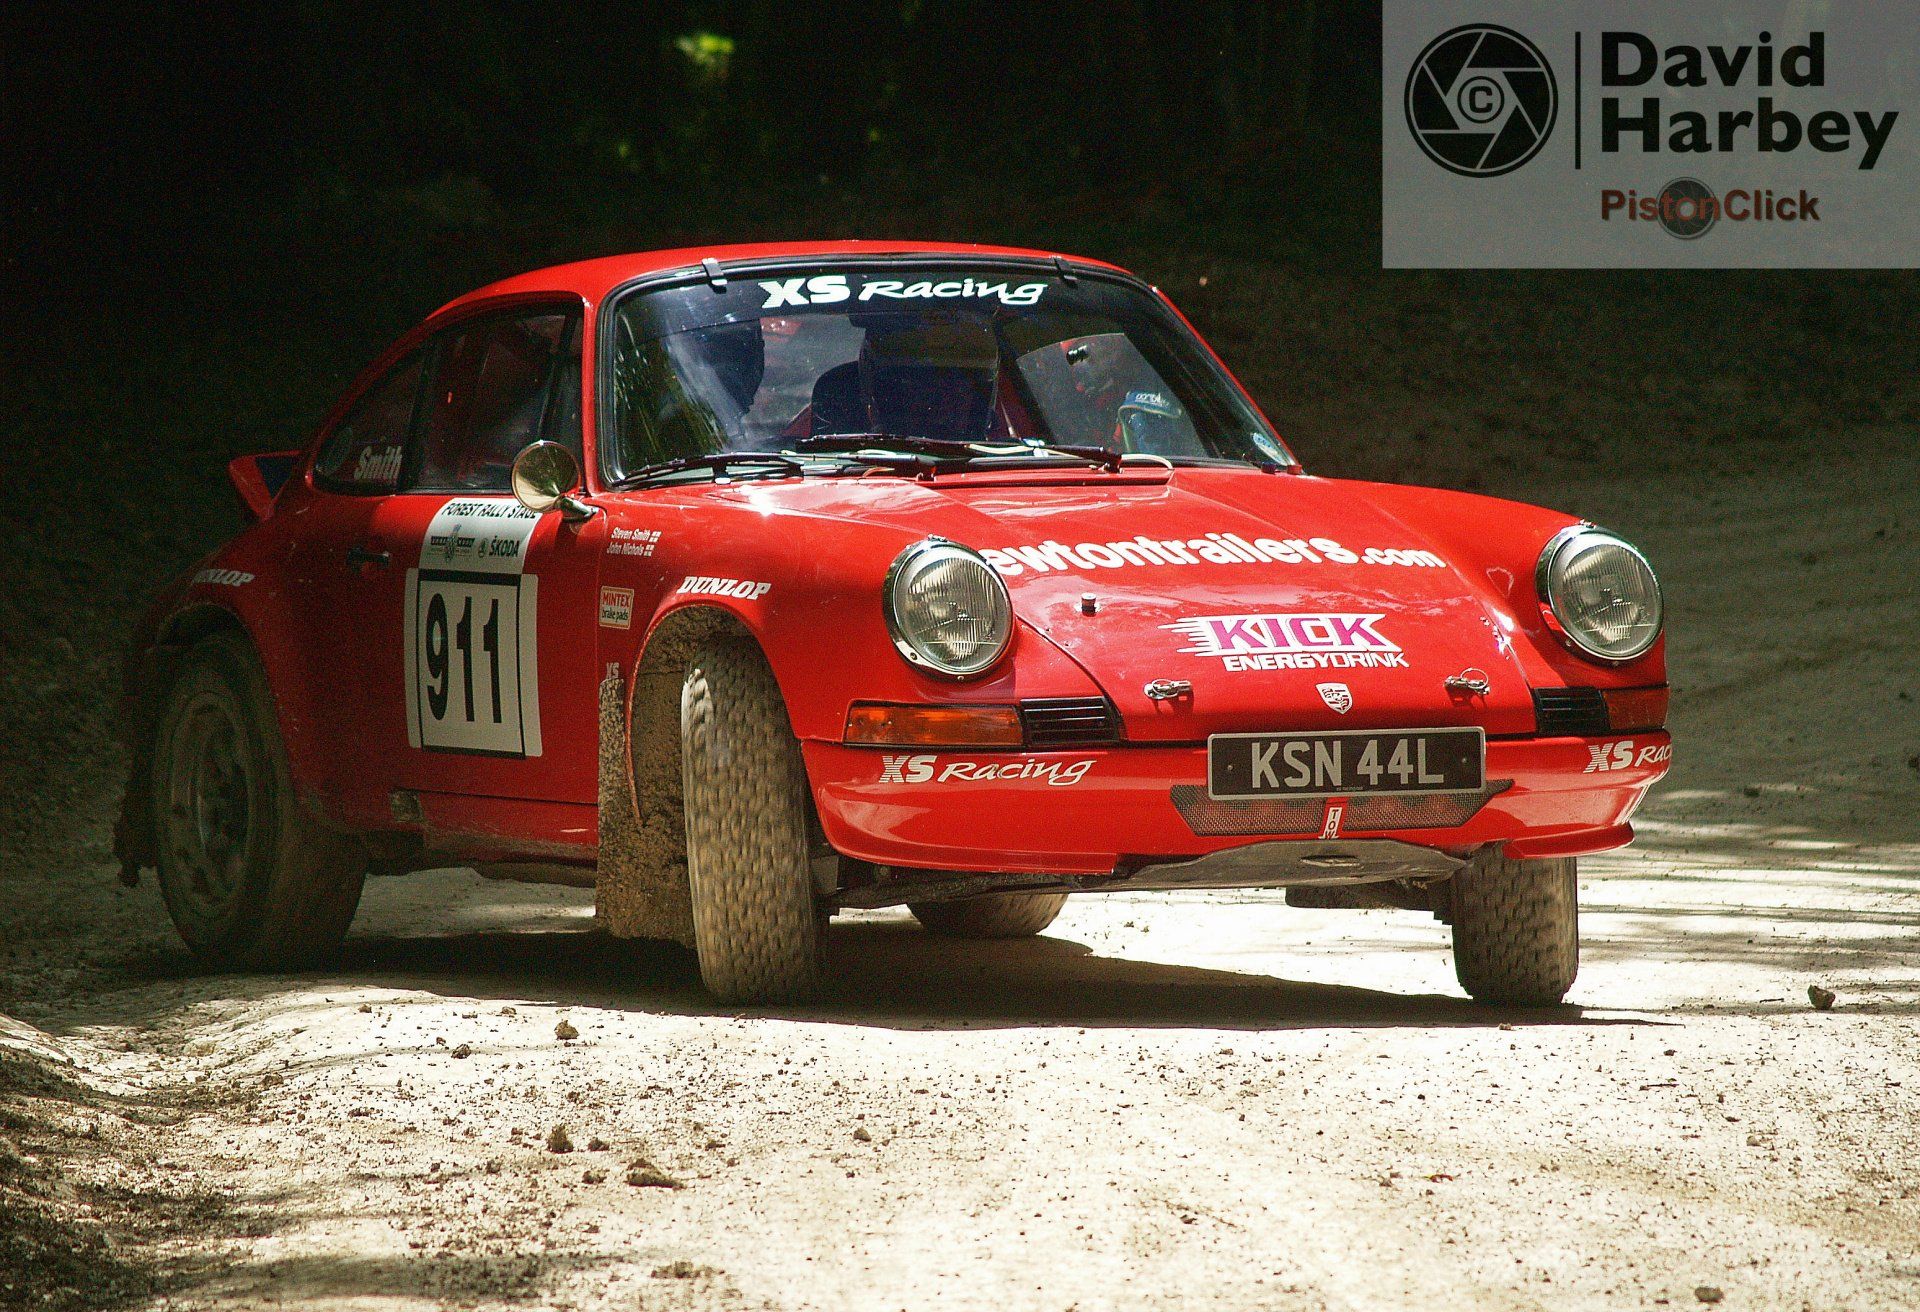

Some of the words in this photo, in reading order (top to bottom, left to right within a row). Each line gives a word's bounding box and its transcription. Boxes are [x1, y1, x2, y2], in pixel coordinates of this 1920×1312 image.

[758, 275, 850, 309] XS
[858, 278, 1047, 305] Racing
[354, 446, 402, 480] Smith
[442, 502, 483, 515] FOREST
[478, 504, 512, 518] RALLY
[489, 535, 519, 558] ŠKODA
[632, 528, 650, 540] Smith
[601, 593, 631, 608] MINTEX
[676, 576, 772, 600] DUNLOP
[1208, 617, 1387, 650] KICK
[426, 592, 502, 724] 911
[1222, 652, 1410, 672] ENERGYDRINK
[879, 755, 938, 783] XS
[937, 758, 1097, 786] Racing
[1252, 739, 1342, 789] KSN
[1357, 738, 1444, 786] 44L
[1583, 740, 1634, 774] XS
